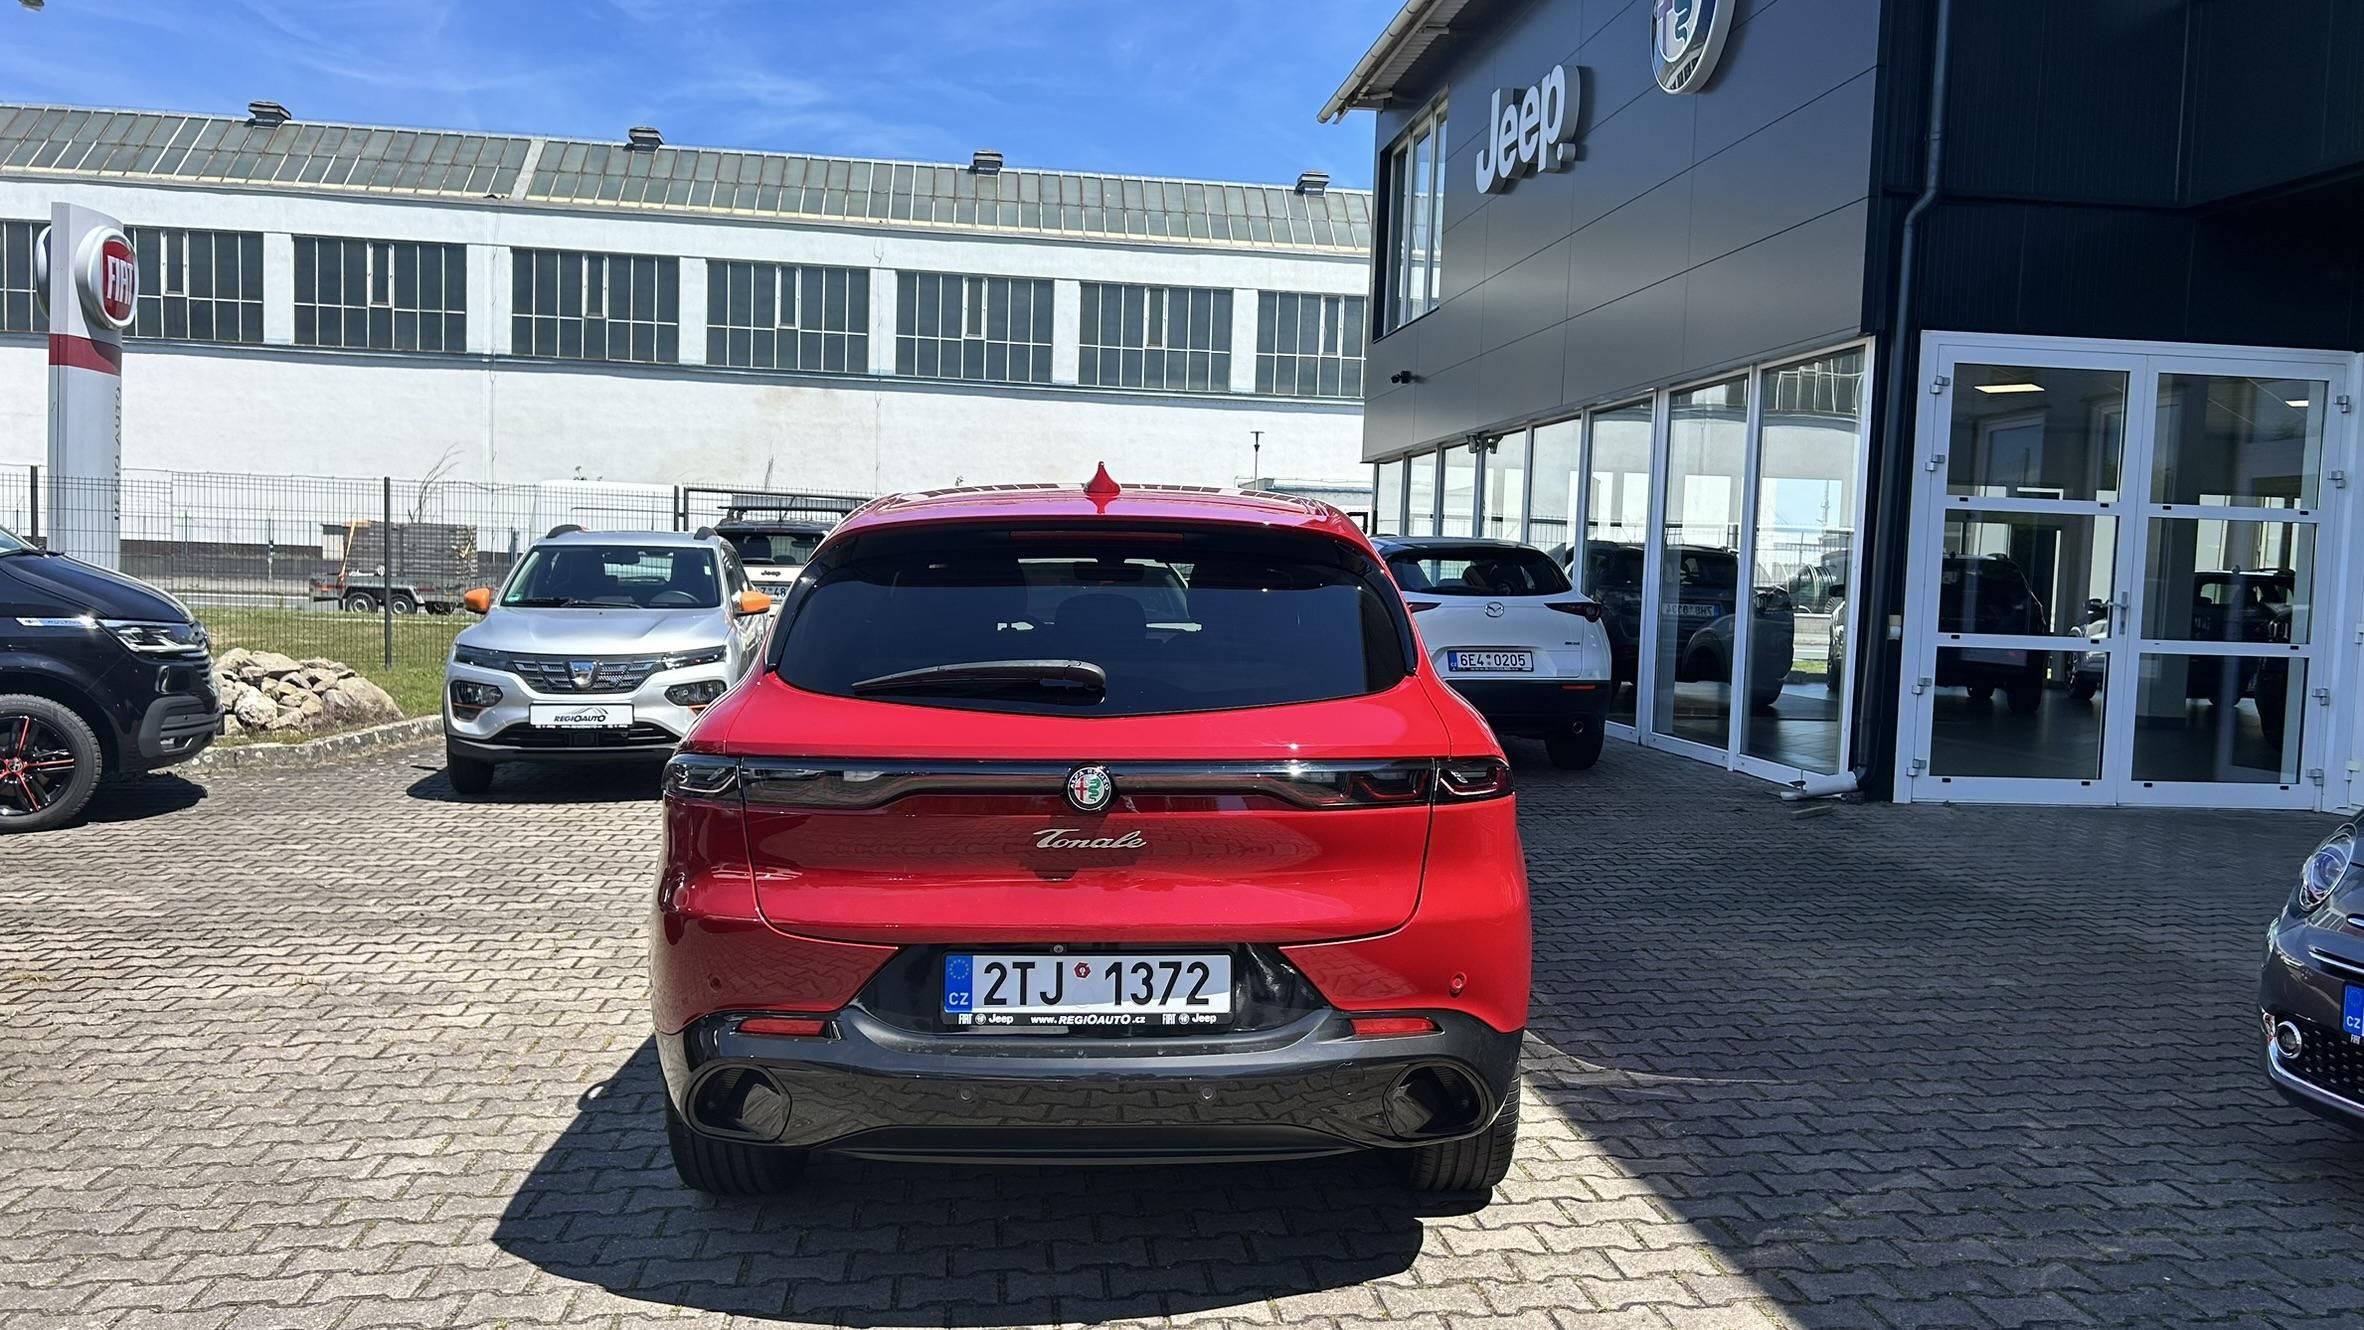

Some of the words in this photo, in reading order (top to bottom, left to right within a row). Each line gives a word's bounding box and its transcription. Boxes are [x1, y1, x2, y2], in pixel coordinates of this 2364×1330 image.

[107, 255, 133, 306] FIAT
[1460, 654, 1484, 666] 6E4
[1494, 654, 1526, 666] 0205
[1033, 829, 1147, 849] Tonale
[984, 961, 1063, 1006] 2TJ
[1105, 961, 1210, 1006] 1372
[948, 992, 969, 1005] CZ
[958, 1013, 973, 1025] FIAT
[988, 1013, 1014, 1025] Jeep
[1162, 1013, 1176, 1025] FIAT
[1191, 1012, 1217, 1025] Jeep
[2346, 1015, 2360, 1029] CZ
